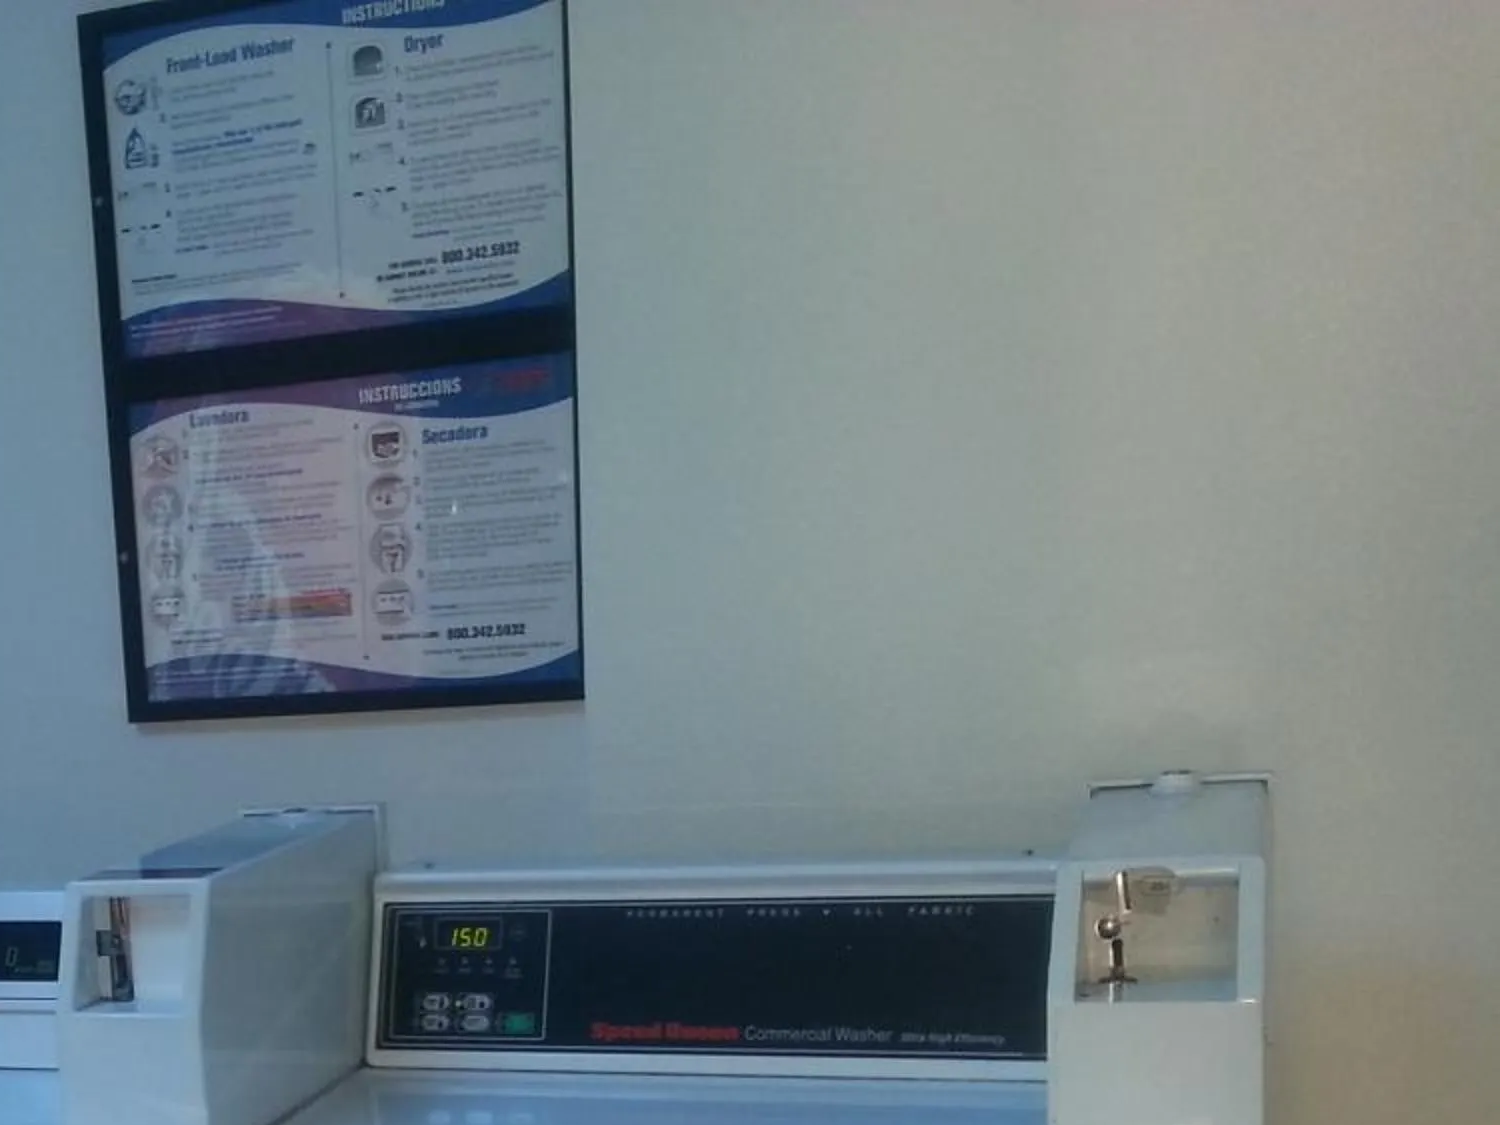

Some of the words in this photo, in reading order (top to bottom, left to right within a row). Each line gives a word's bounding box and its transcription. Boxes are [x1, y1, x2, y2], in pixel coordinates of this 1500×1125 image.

[241, 37, 295, 61] Washer
[404, 33, 443, 54] Dryer
[422, 425, 489, 445] Secadora
[744, 1024, 832, 1042] Commercial
[835, 1025, 894, 1043] Washer
